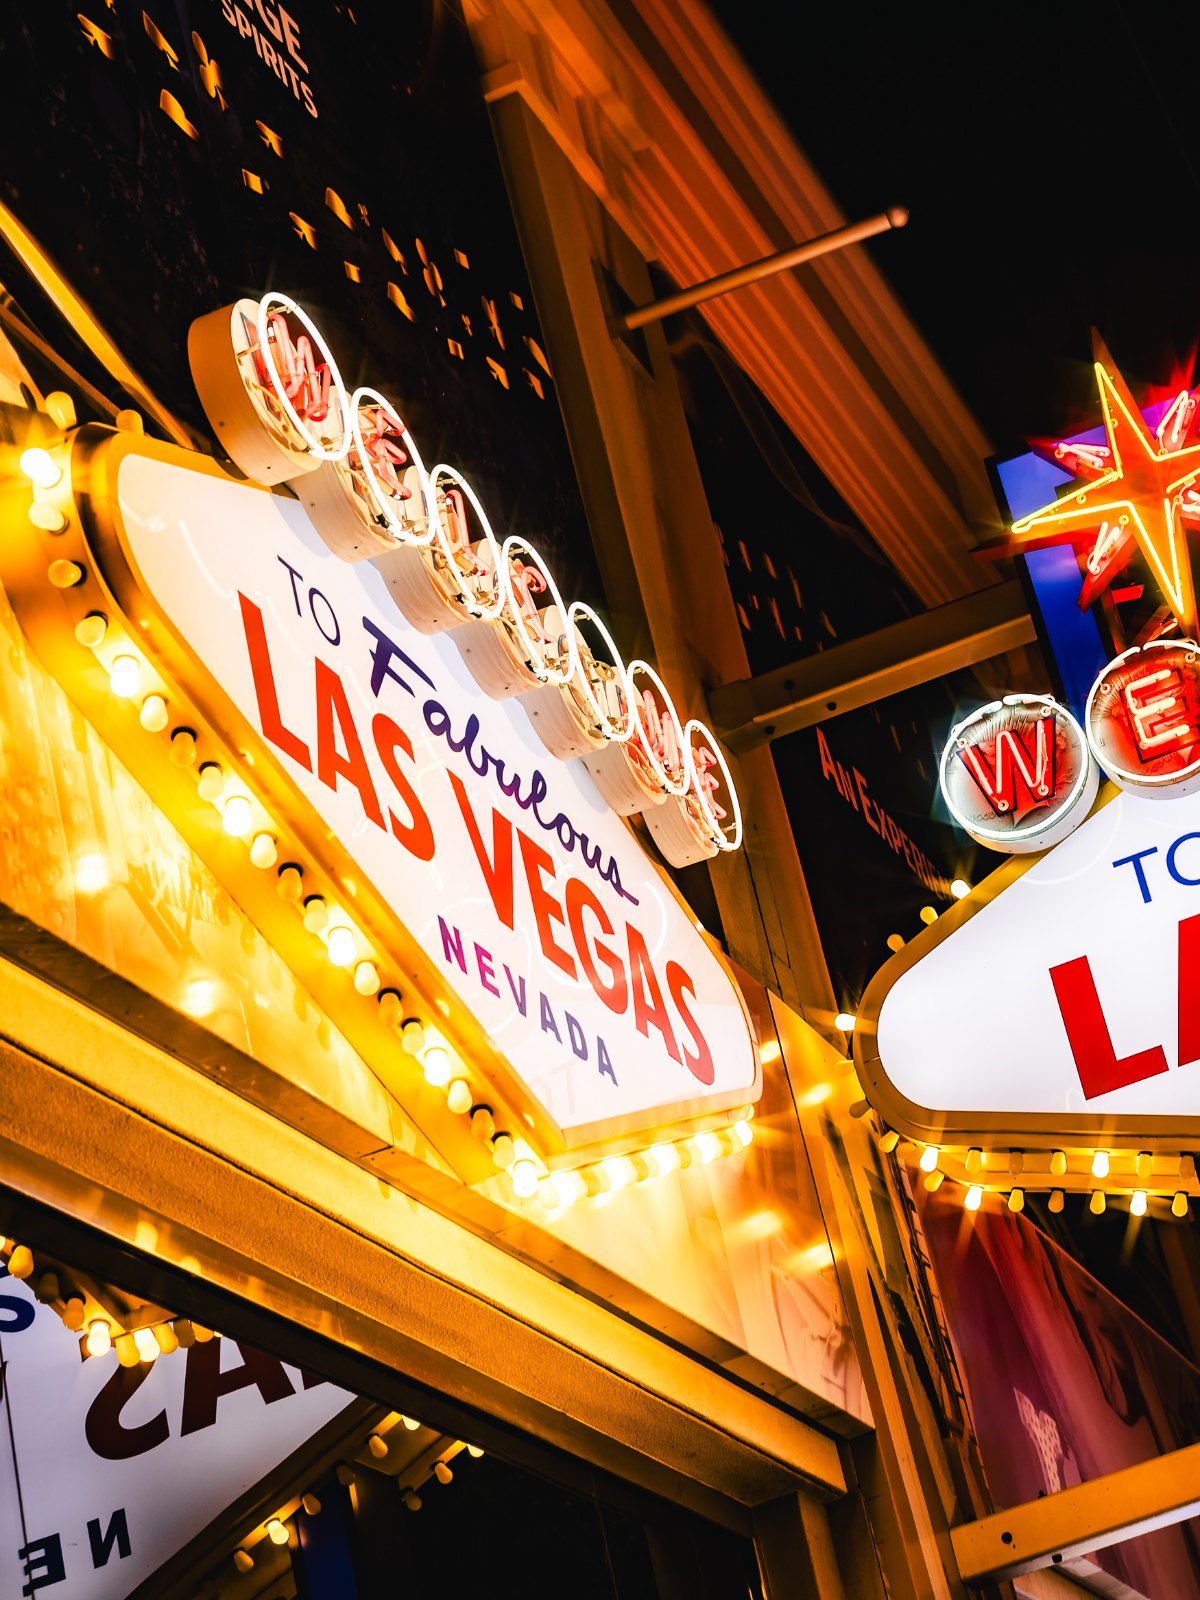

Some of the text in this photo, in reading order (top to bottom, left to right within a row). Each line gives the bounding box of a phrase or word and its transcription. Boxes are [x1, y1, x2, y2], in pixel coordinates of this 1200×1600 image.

[222, 0, 318, 118] SPIRITS
[244, 0, 309, 74] GE
[277, 555, 640, 906] TO Fabulous
[237, 590, 715, 1086] LAS VEGAS
[437, 915, 619, 1088] NEVADA
